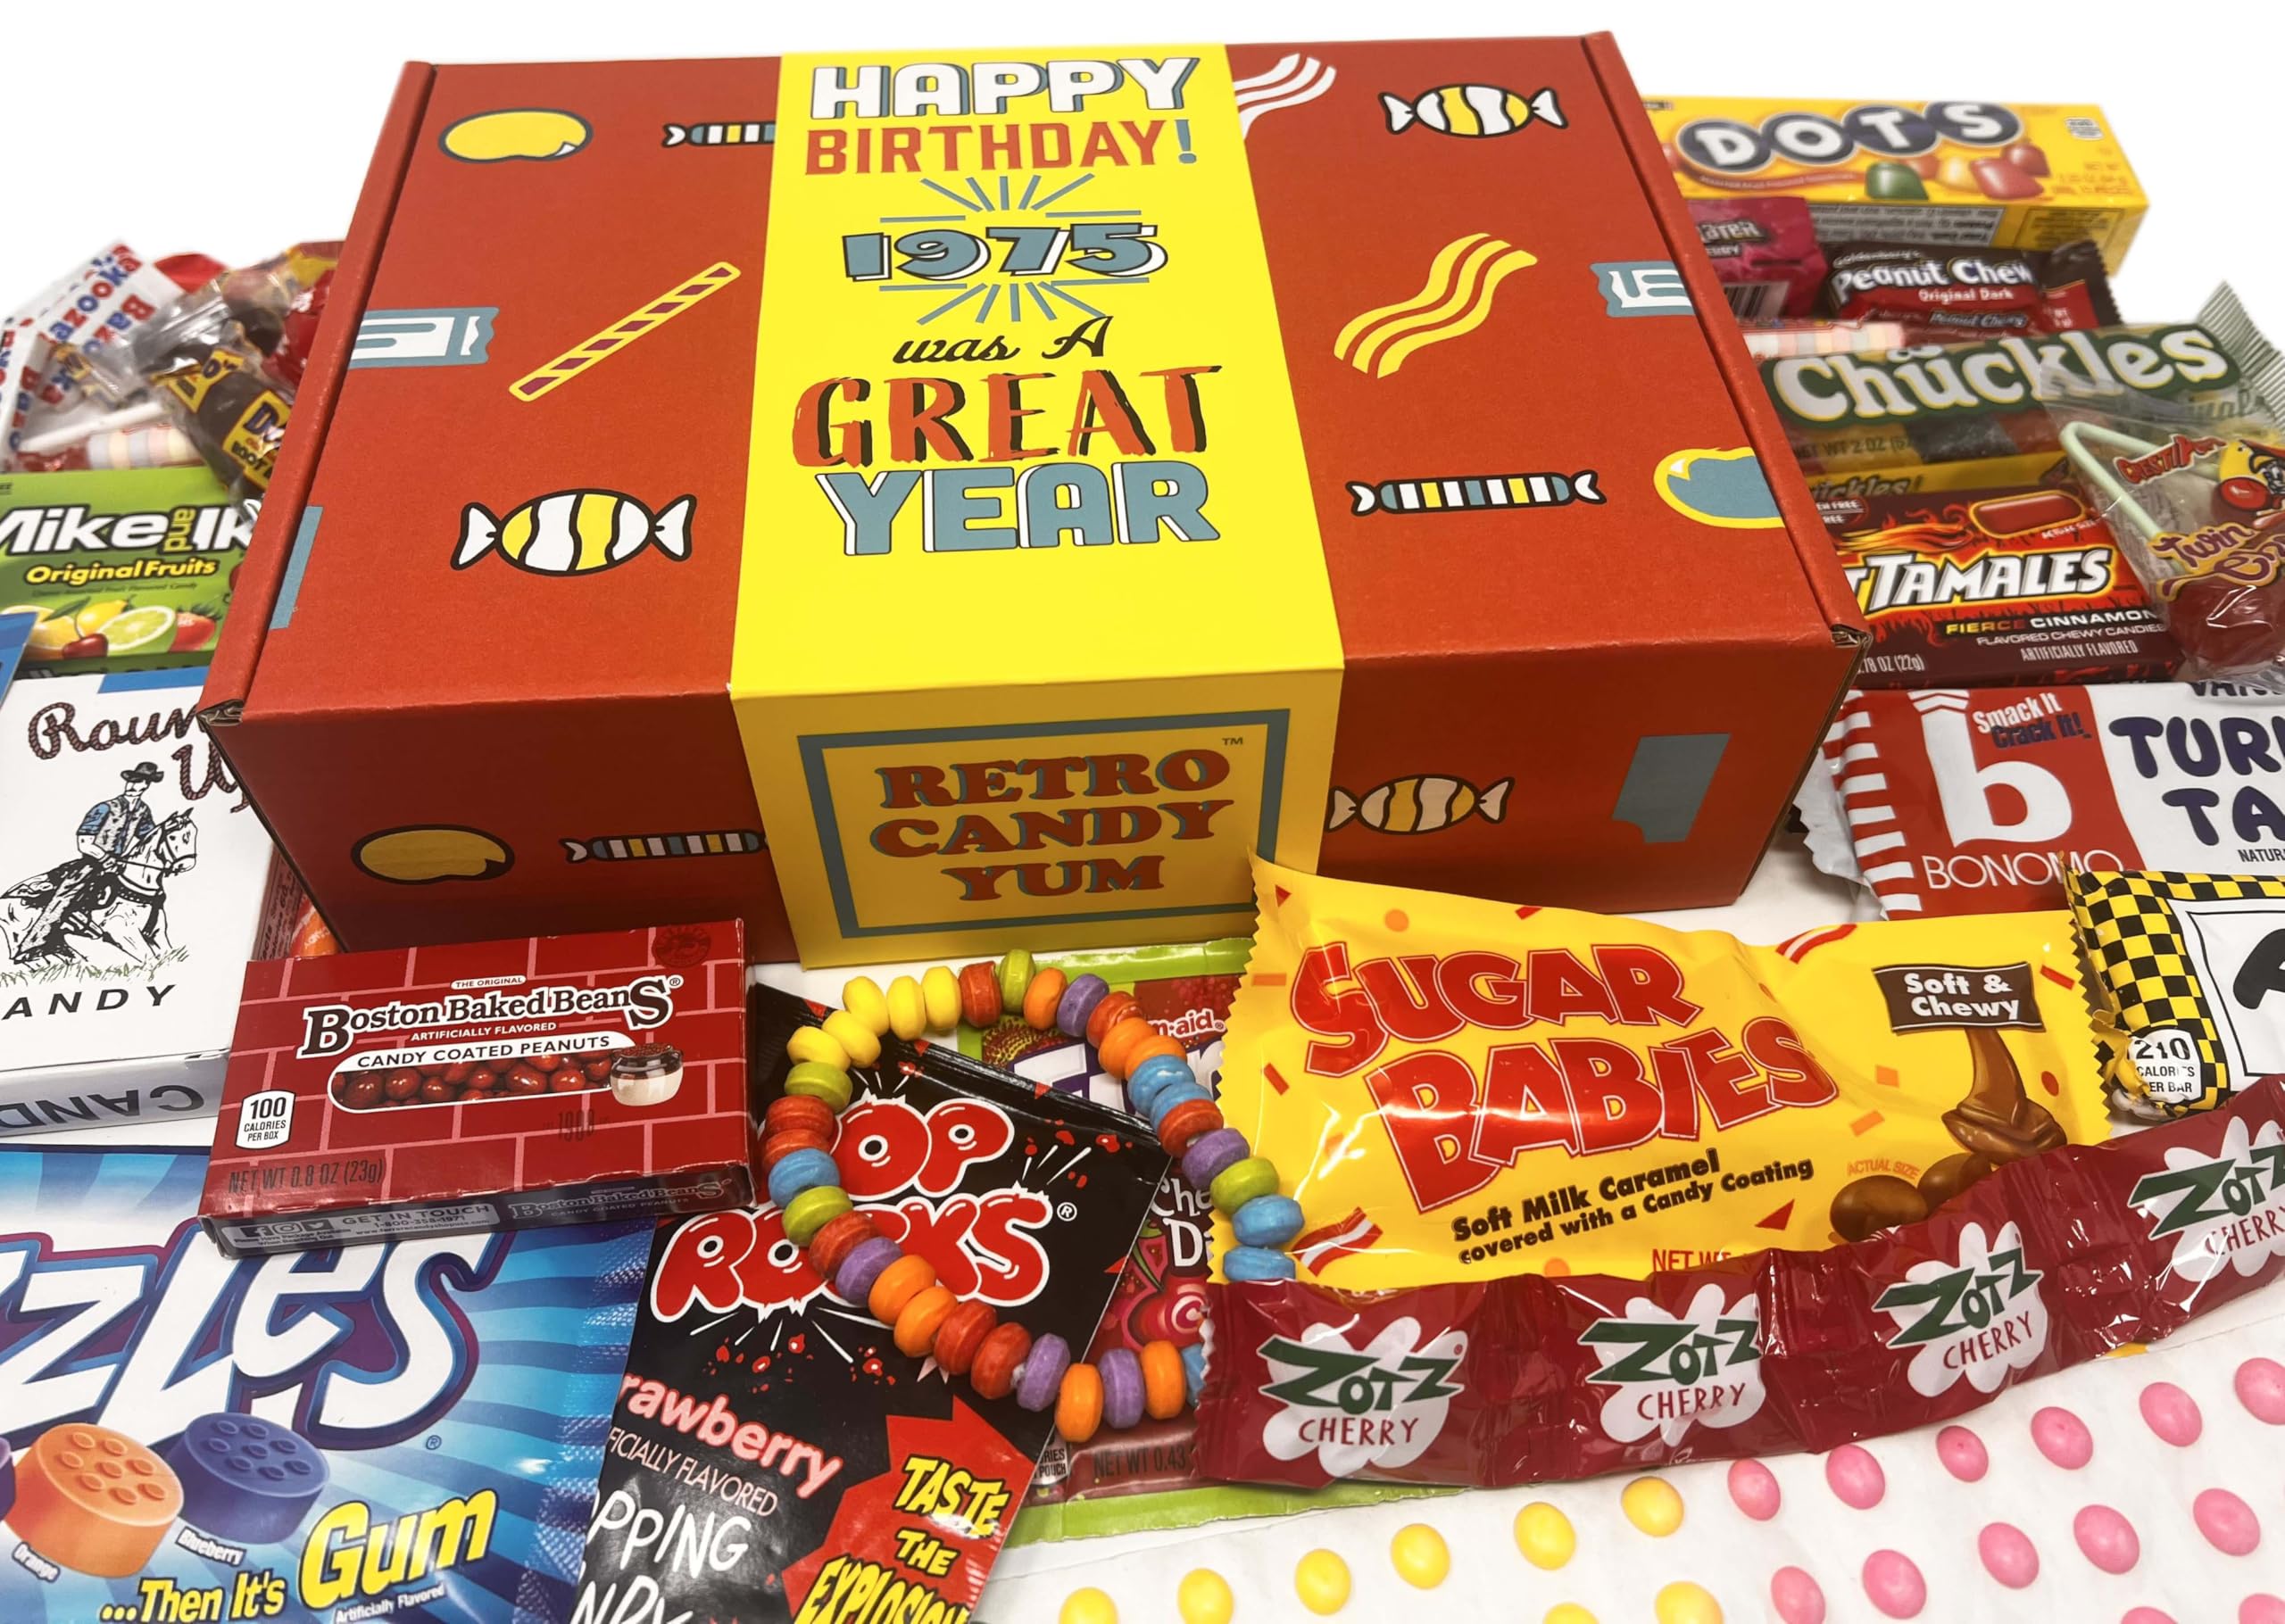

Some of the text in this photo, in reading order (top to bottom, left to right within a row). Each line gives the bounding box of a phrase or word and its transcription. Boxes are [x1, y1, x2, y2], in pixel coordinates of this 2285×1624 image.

[810, 56, 1201, 120] HAPPY
[805, 119, 1198, 175] BIRTHDAY!
[1692, 103, 2008, 168] DOTS
[842, 223, 1169, 282] 1975
[37, 255, 143, 346] azooka
[1832, 259, 1948, 305] Peanut
[1918, 287, 2015, 303] Original Dark
[893, 316, 1115, 363] was A
[793, 365, 1223, 468] GREAT
[0, 505, 170, 553] Mike
[814, 460, 1221, 557] YEAR
[26, 557, 219, 586] Original Fruits
[1865, 548, 2112, 613] TAMALES
[1945, 619, 2026, 636] FIERCE
[1976, 633, 2049, 647] FLAVORED
[2050, 628, 2104, 642] CHEWY
[2021, 639, 2139, 662] ARTIFICIALLY FLAVORED
[1878, 656, 1895, 672] OZ
[1896, 653, 1925, 674] (22g)
[1972, 692, 2063, 734] Smack It
[1991, 717, 2056, 749] Crack
[2108, 716, 2285, 779] TUR
[875, 749, 1230, 808] RETRO
[869, 800, 1234, 858] CANDY
[941, 855, 1165, 901] YUM
[1, 983, 177, 1021] ANDY
[455, 976, 523, 990] THE ORIGINAL
[1904, 972, 2013, 995] Soft &
[296, 1003, 442, 1060] Boston
[445, 988, 547, 1024] Baked
[1292, 941, 1702, 1077] SUGAR
[1911, 995, 2020, 1021] Chewy
[357, 1035, 611, 1068] CANDY COATED PEANUTS
[411, 1022, 557, 1042] ARTIFICIALLY FLAVORED
[2134, 1037, 2191, 1060] 210
[2136, 1065, 2196, 1078] CALORS
[244, 1119, 287, 1132] CALORIES
[250, 1096, 287, 1120] 100
[1367, 1015, 1841, 1214] BABIES
[247, 1130, 279, 1142] PER BOX
[760, 1096, 1015, 1205] OP
[228, 1158, 384, 1194] NET WT 0.8 OZ (23g)
[1846, 1158, 1921, 1181] ACTUAL SIZE
[342, 1205, 490, 1225] GET IN TOUCH
[1451, 1148, 1721, 1243] Soft Milk Caramel
[1458, 1157, 1815, 1265] covered with a Candy Coating
[2205, 1206, 2285, 1255] CHERR
[650, 1188, 1053, 1323] ROKS
[1652, 1248, 1694, 1272] NET
[1873, 1247, 2044, 1347] ZOTZ
[1578, 1319, 1765, 1386] ZOTZ
[1943, 1311, 2033, 1370] CHERRY
[1257, 1336, 1465, 1416] ZOTZ
[1637, 1382, 1746, 1421] CHERRY
[1299, 1417, 1419, 1446] CHERRY
[1093, 1444, 1186, 1479] NET WT 0.43
[675, 1455, 779, 1517] FLAVORED
[893, 1454, 1013, 1537] TASTE
[178, 1528, 245, 1566] Blueberry
[300, 1488, 497, 1609] Gum
[586, 1488, 752, 1579] PPING
[894, 1528, 961, 1577] THE
[12, 1543, 60, 1581] Orange
[229, 1570, 287, 1621] It's
[335, 1581, 446, 1624] Artificially Flavored
